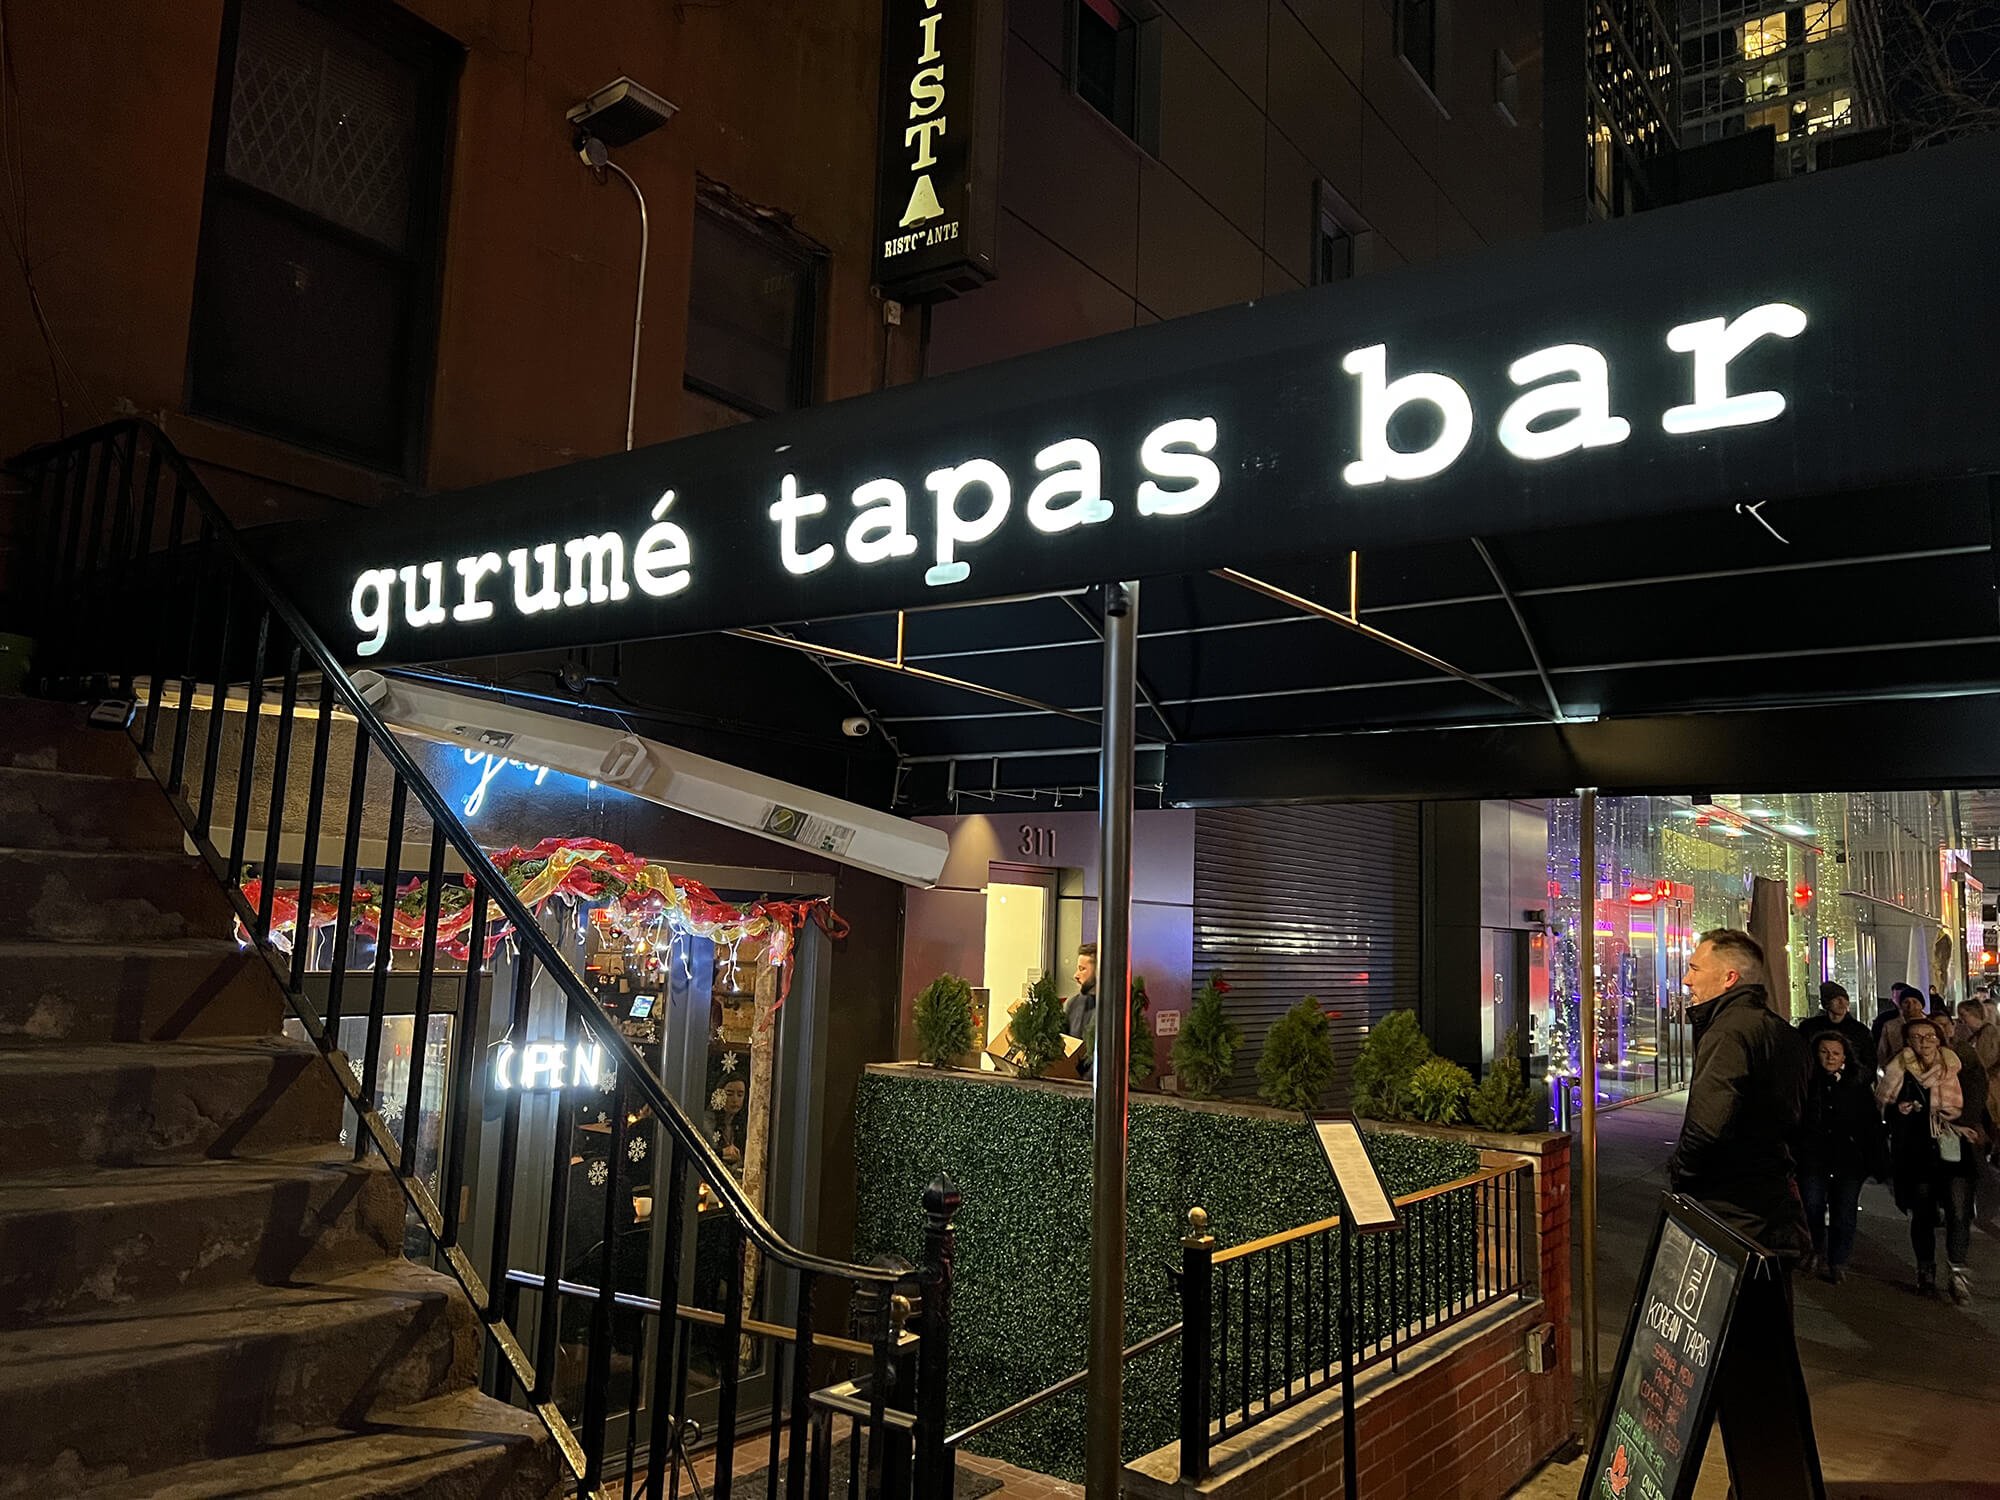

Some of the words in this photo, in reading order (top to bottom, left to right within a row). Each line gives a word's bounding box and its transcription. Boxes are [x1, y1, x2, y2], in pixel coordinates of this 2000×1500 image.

[899, 0, 946, 228] ISTA
[350, 490, 692, 656] gurumé
[769, 417, 1221, 586] tapas
[1341, 302, 1808, 487] bar
[1022, 825, 1056, 857] 311
[1645, 1295, 1682, 1344] KOREAN
[1683, 1323, 1710, 1367] TAPAS
